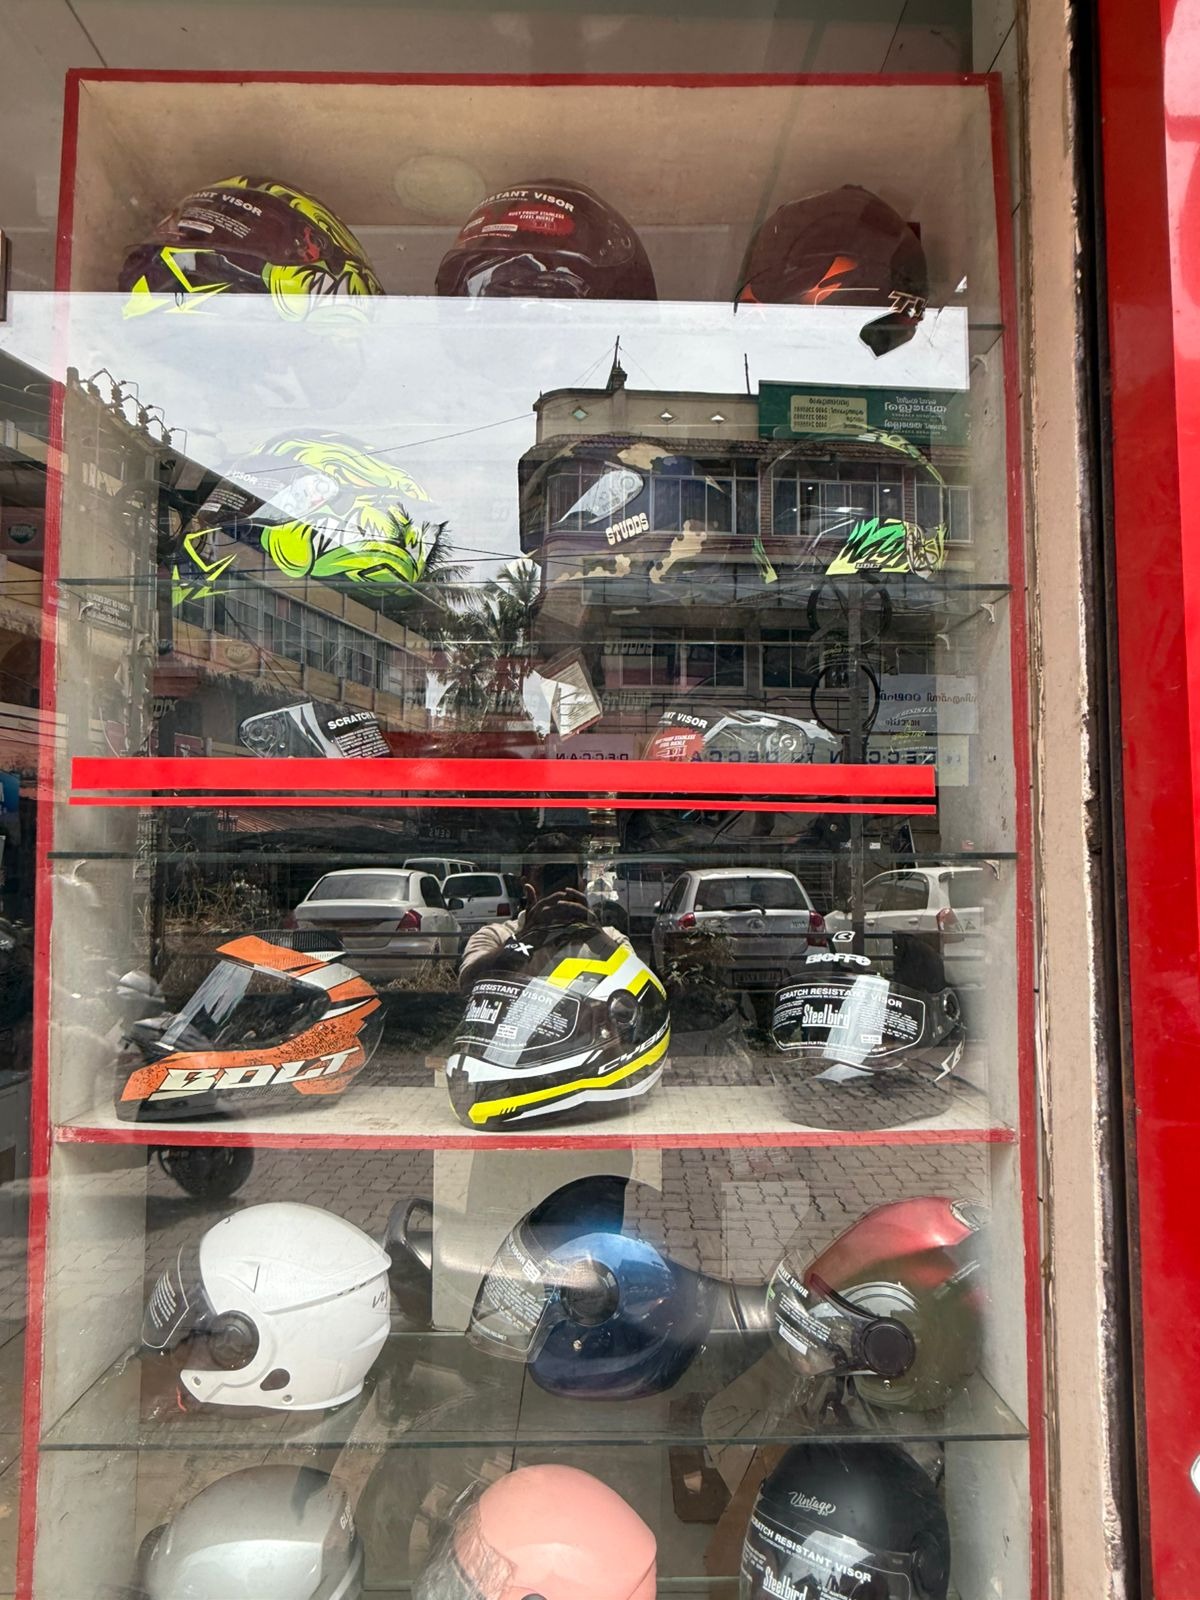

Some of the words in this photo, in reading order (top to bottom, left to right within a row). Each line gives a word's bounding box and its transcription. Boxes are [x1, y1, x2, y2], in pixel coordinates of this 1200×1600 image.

[222, 194, 263, 217] VISOR
[533, 191, 575, 212] VISOR
[605, 512, 650, 546] STUDDS
[676, 713, 708, 729] VISOR
[522, 990, 553, 1005] VISOR
[779, 987, 809, 1002] SCRATCH
[810, 986, 866, 999] RESISTANT
[870, 993, 903, 1008] VISOR
[801, 1003, 851, 1025] Steelbird
[159, 1046, 360, 1091] BOLT
[790, 1277, 809, 1299] VISOR
[788, 1491, 837, 1517] Vintage
[774, 1532, 833, 1567] RESISTANT
[835, 1561, 872, 1583] VISOR
[762, 1566, 809, 1600] Steelbird
